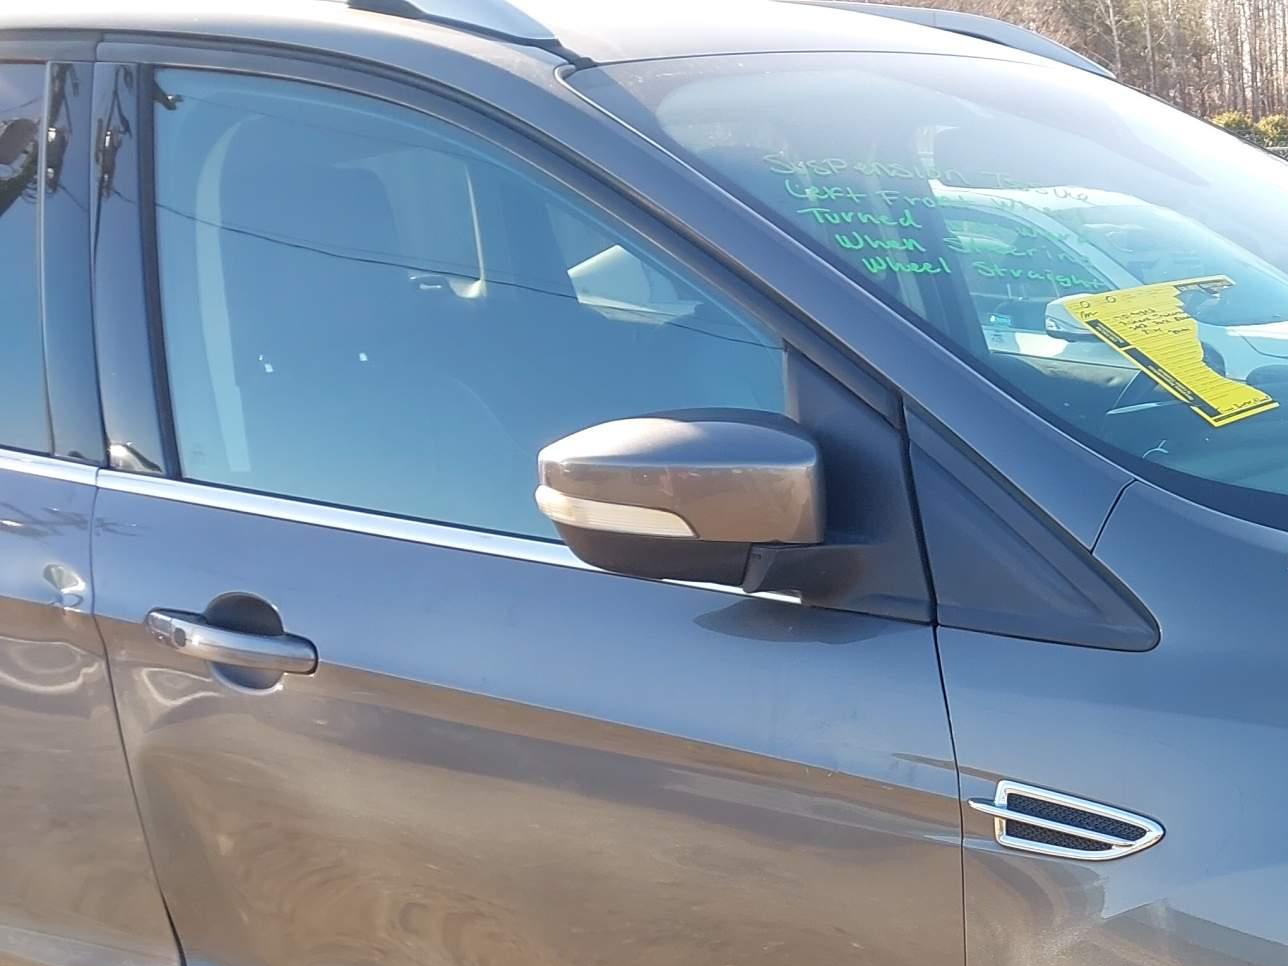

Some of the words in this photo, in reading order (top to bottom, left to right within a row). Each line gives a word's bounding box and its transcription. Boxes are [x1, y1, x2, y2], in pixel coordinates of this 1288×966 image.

[795, 207, 922, 229] Turned
[835, 233, 927, 253] When
[862, 257, 952, 276] Wheel
